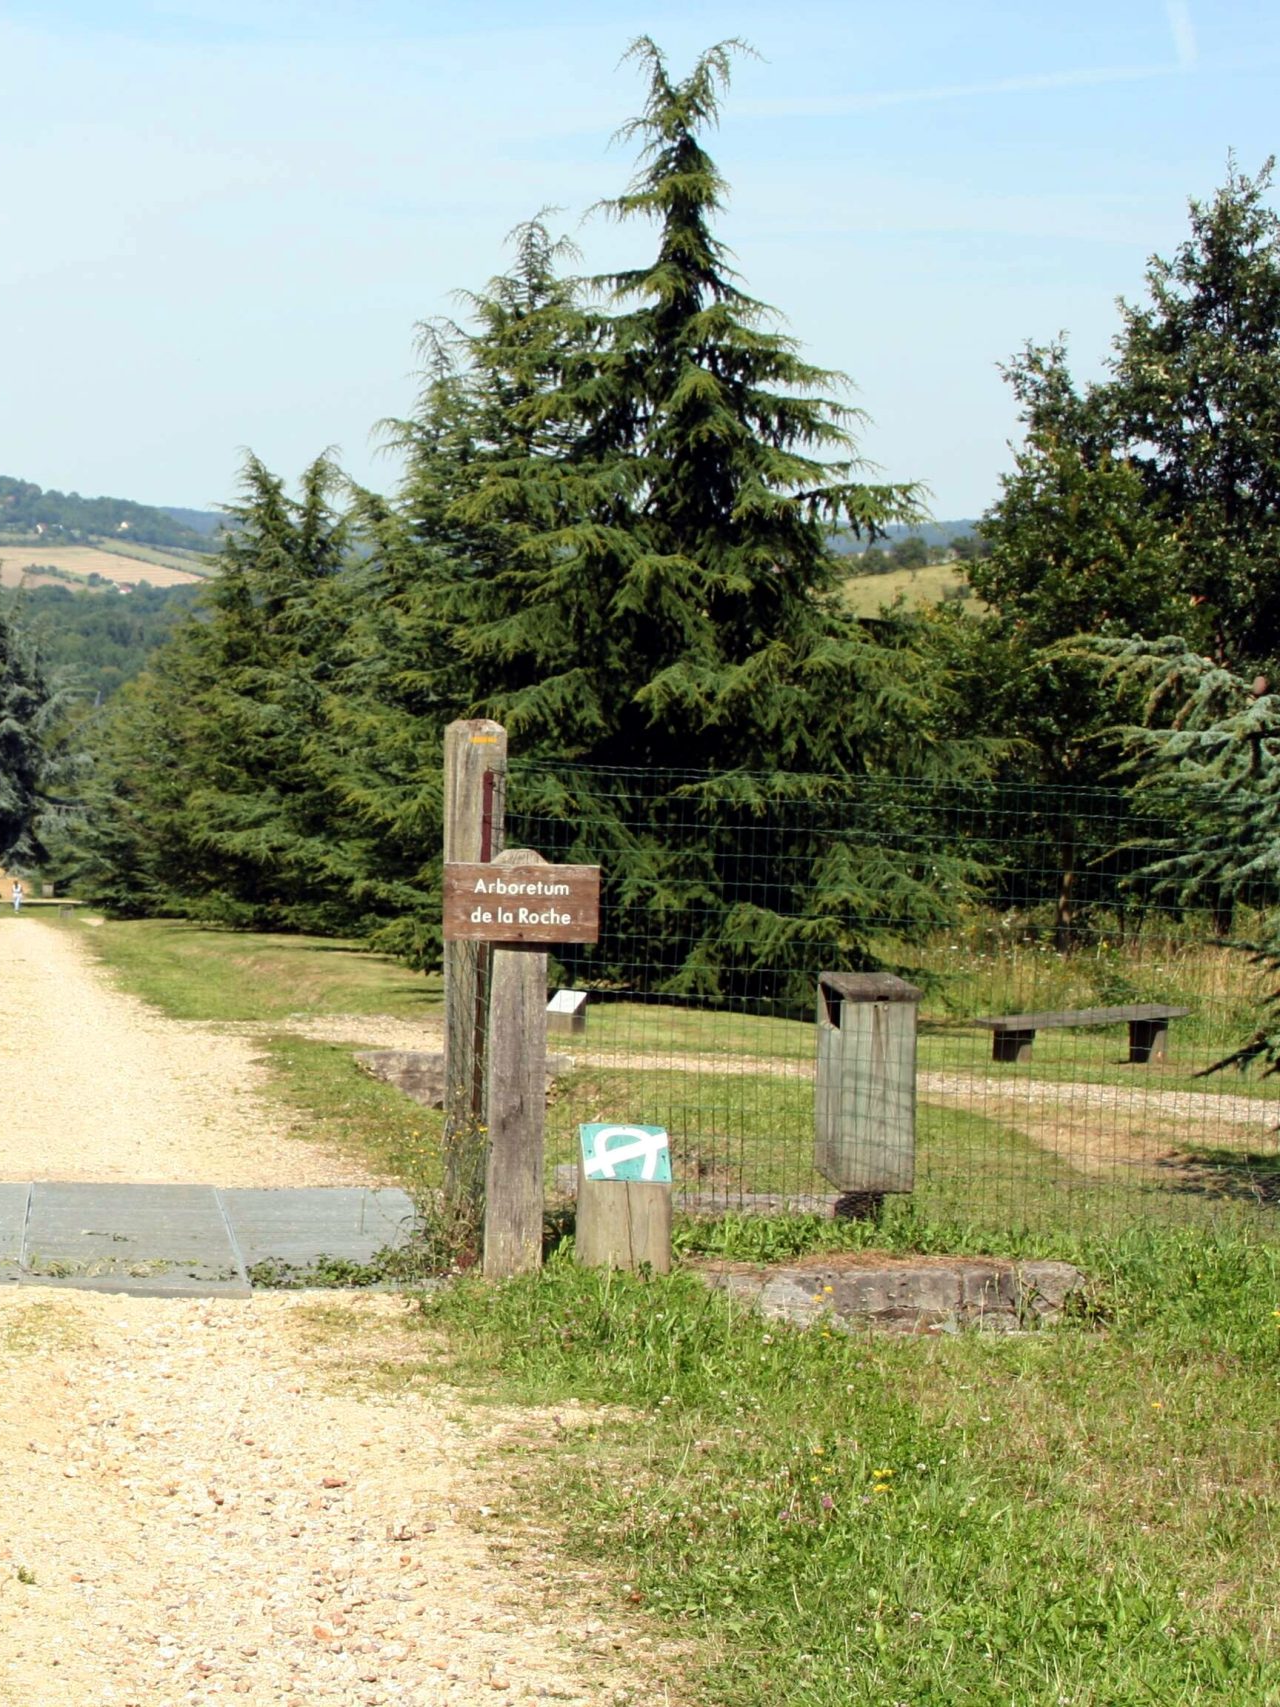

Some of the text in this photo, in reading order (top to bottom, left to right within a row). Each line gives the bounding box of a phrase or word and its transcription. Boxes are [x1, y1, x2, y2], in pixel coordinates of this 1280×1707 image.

[474, 878, 570, 896] Arboretum
[470, 906, 571, 925] de la Roche
